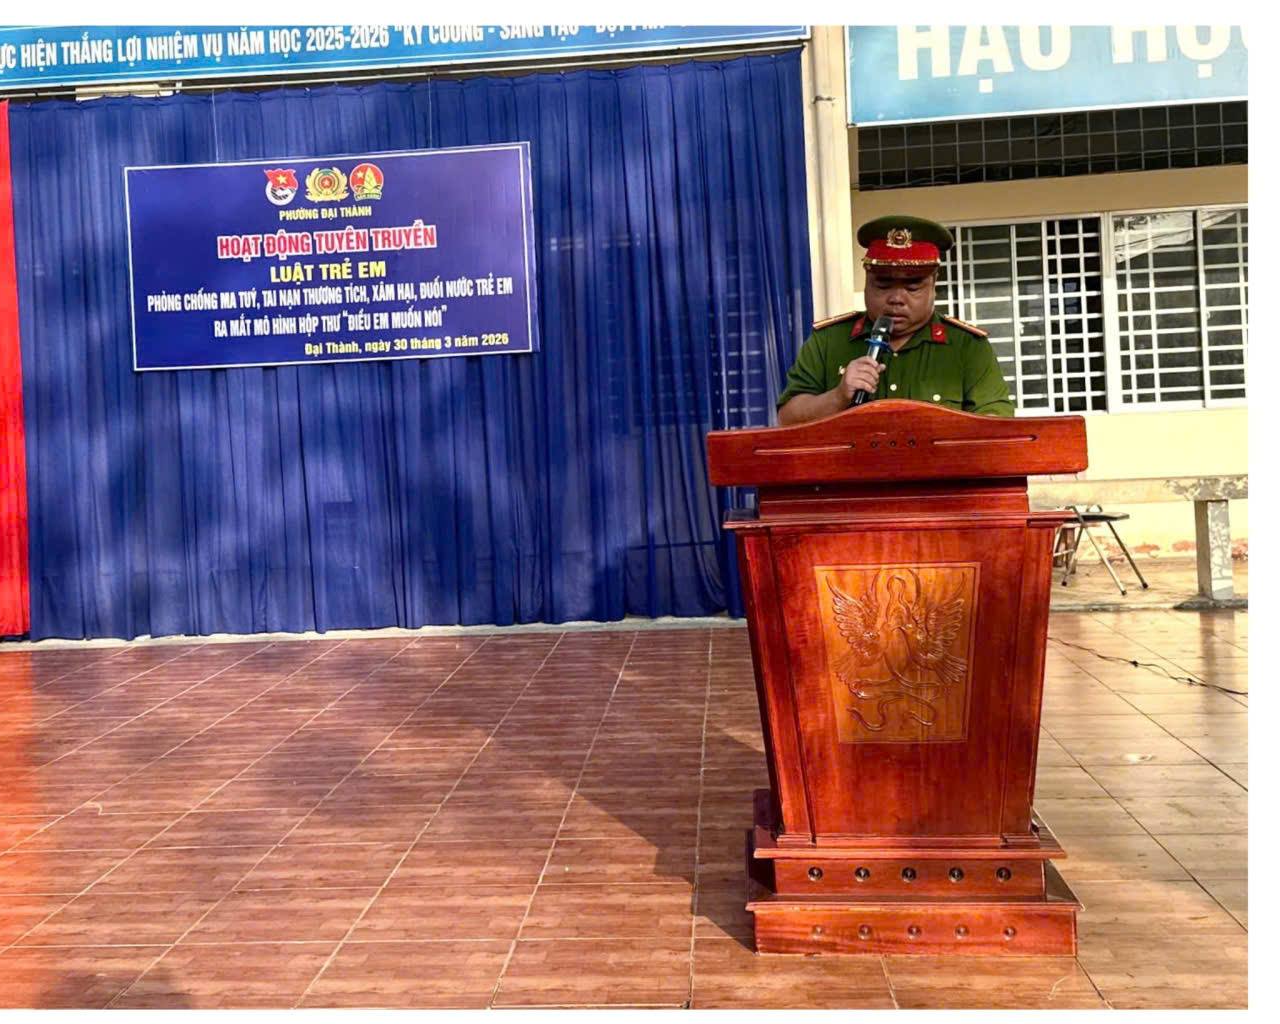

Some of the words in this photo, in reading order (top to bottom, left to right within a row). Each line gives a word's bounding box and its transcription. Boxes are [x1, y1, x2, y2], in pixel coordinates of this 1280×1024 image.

[20, 38, 57, 71] HIỆN
[61, 31, 113, 65] THẮNG
[117, 35, 142, 67] LỢI
[146, 30, 198, 64] NHIỆM
[202, 32, 223, 62] VỤ
[227, 26, 265, 56] NĂM
[269, 28, 302, 58] HỌC
[306, 25, 389, 51] 2025-2026
[279, 207, 319, 221] PHƯỜNG
[321, 208, 337, 220] ĐẠI
[340, 205, 372, 218] THÀNH
[218, 234, 262, 262] HOẠT
[264, 229, 312, 260] ĐỘNG
[313, 225, 369, 254] TUYÊN
[270, 262, 314, 285] LUẬT
[319, 257, 352, 280] TRẺ
[358, 260, 386, 279] EM
[147, 290, 182, 312] PHÒNG
[184, 287, 218, 310] CHỐNG
[220, 292, 237, 309] MA
[262, 290, 277, 307] TAI
[279, 288, 301, 310] NẠN
[302, 285, 342, 306] THƯƠNG
[344, 282, 370, 304] TÍCH,
[372, 281, 395, 302] XÂM
[397, 282, 417, 303] HẠI,
[419, 275, 444, 299] ĐUỐI
[475, 272, 495, 296] TRẺ
[497, 276, 513, 294] EM
[214, 320, 228, 337] RA
[229, 313, 252, 337] MẮT
[253, 315, 271, 336] MÔ
[272, 314, 297, 334] HÌNH
[299, 312, 319, 337] HỘP
[321, 311, 342, 333] THƯ
[373, 312, 389, 329] EM
[391, 305, 422, 328] MUỐN
[305, 342, 323, 356] Đại
[326, 340, 362, 355] Thành,
[364, 339, 391, 353] ngày
[393, 338, 408, 350] 30
[410, 336, 442, 350] tháng
[444, 336, 452, 347] 3
[454, 334, 479, 347] năm
[482, 333, 509, 346] 2026
